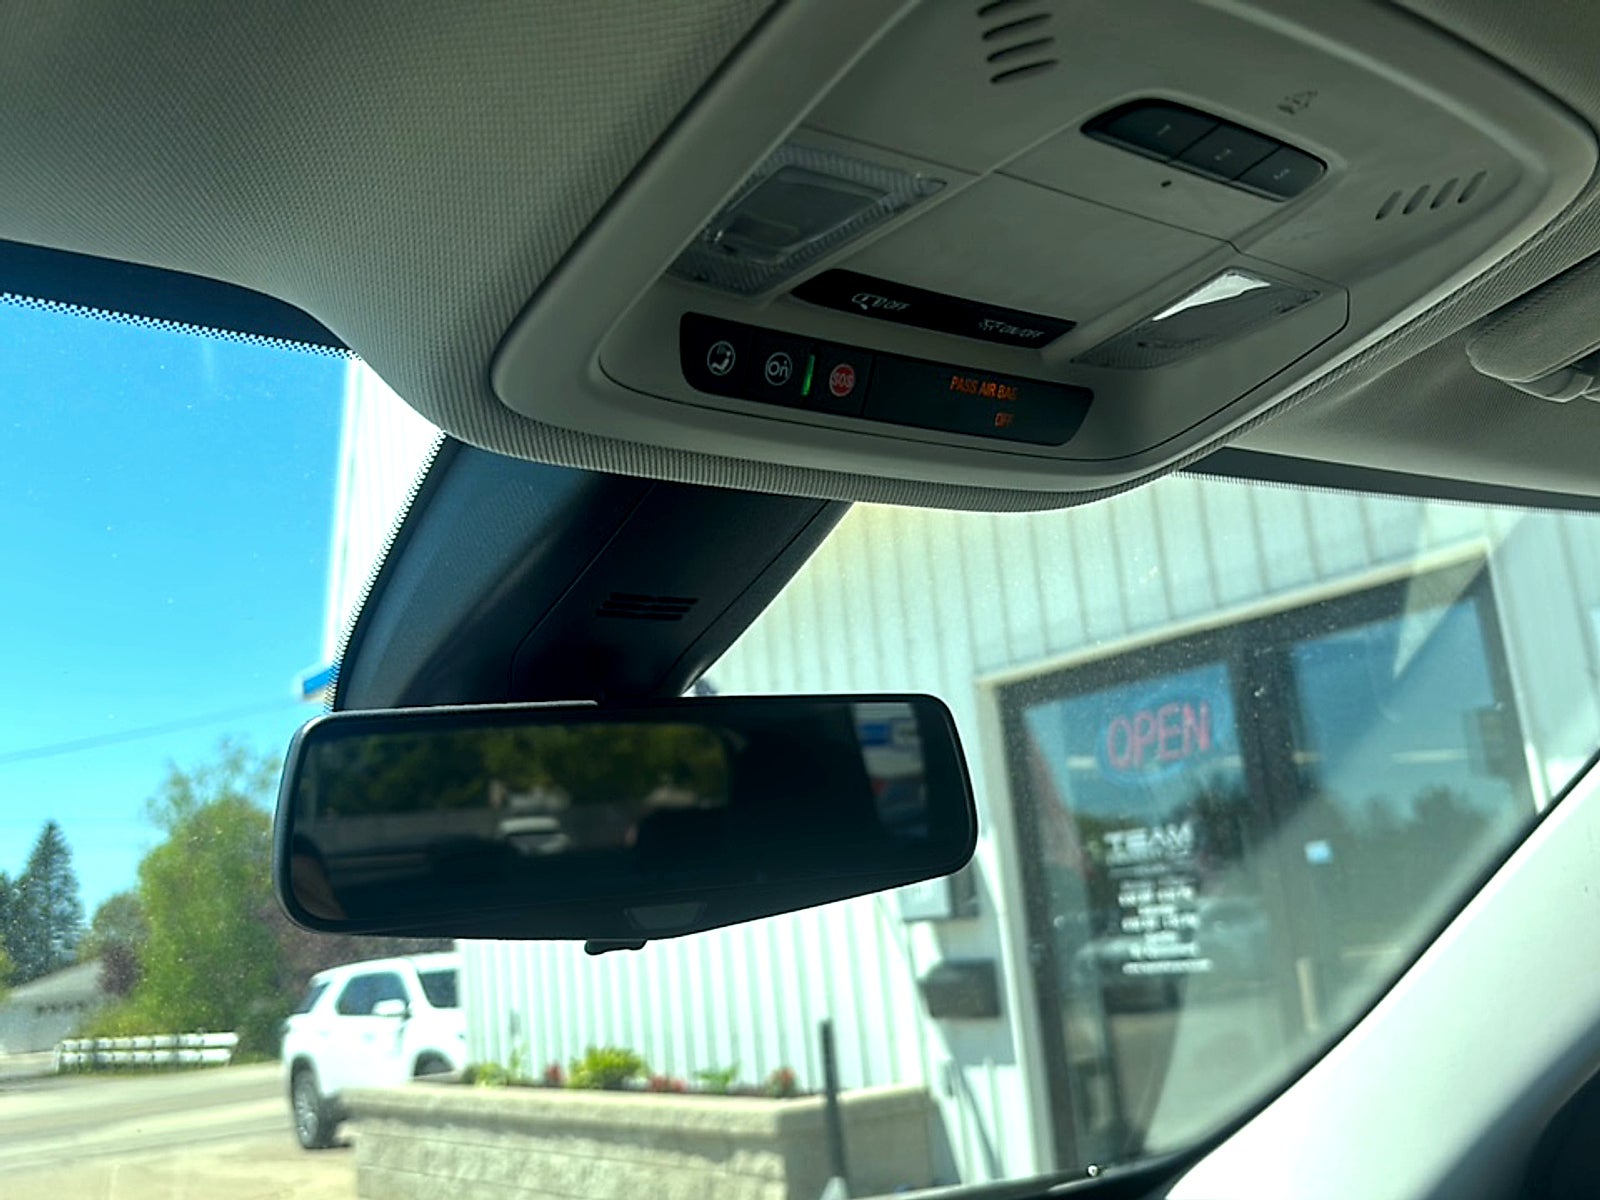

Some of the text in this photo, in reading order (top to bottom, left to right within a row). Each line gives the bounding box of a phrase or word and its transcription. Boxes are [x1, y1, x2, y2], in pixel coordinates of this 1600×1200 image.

[830, 372, 855, 388] SOS
[950, 375, 978, 395] PASS
[979, 380, 997, 398] AIR
[994, 411, 1015, 428] OFF
[1107, 701, 1212, 771] OPEN
[1103, 821, 1194, 852] TEAM
